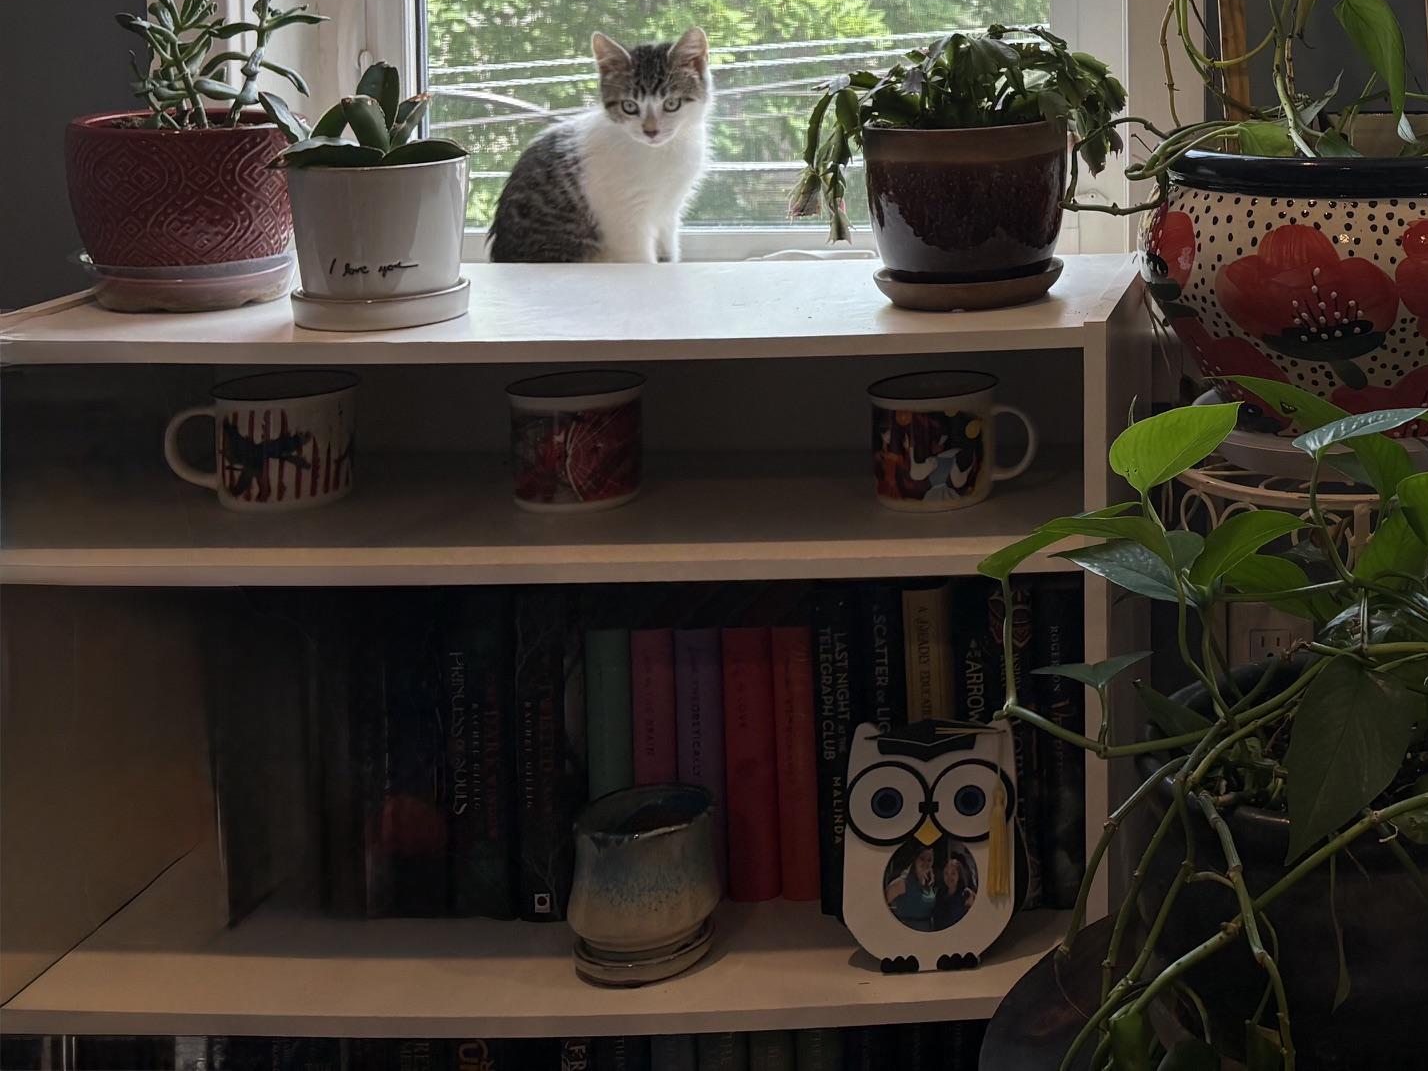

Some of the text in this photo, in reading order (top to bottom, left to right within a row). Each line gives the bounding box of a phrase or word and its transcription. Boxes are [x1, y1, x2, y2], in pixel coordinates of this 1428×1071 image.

[329, 258, 419, 278] I love you
[833, 632, 848, 670] LAST
[872, 614, 889, 687] SCATTER
[818, 626, 837, 761] TELEGRAPH CLUB
[835, 672, 850, 720] NIGHT
[876, 707, 892, 735] LIG
[831, 776, 844, 846] MALINDA
